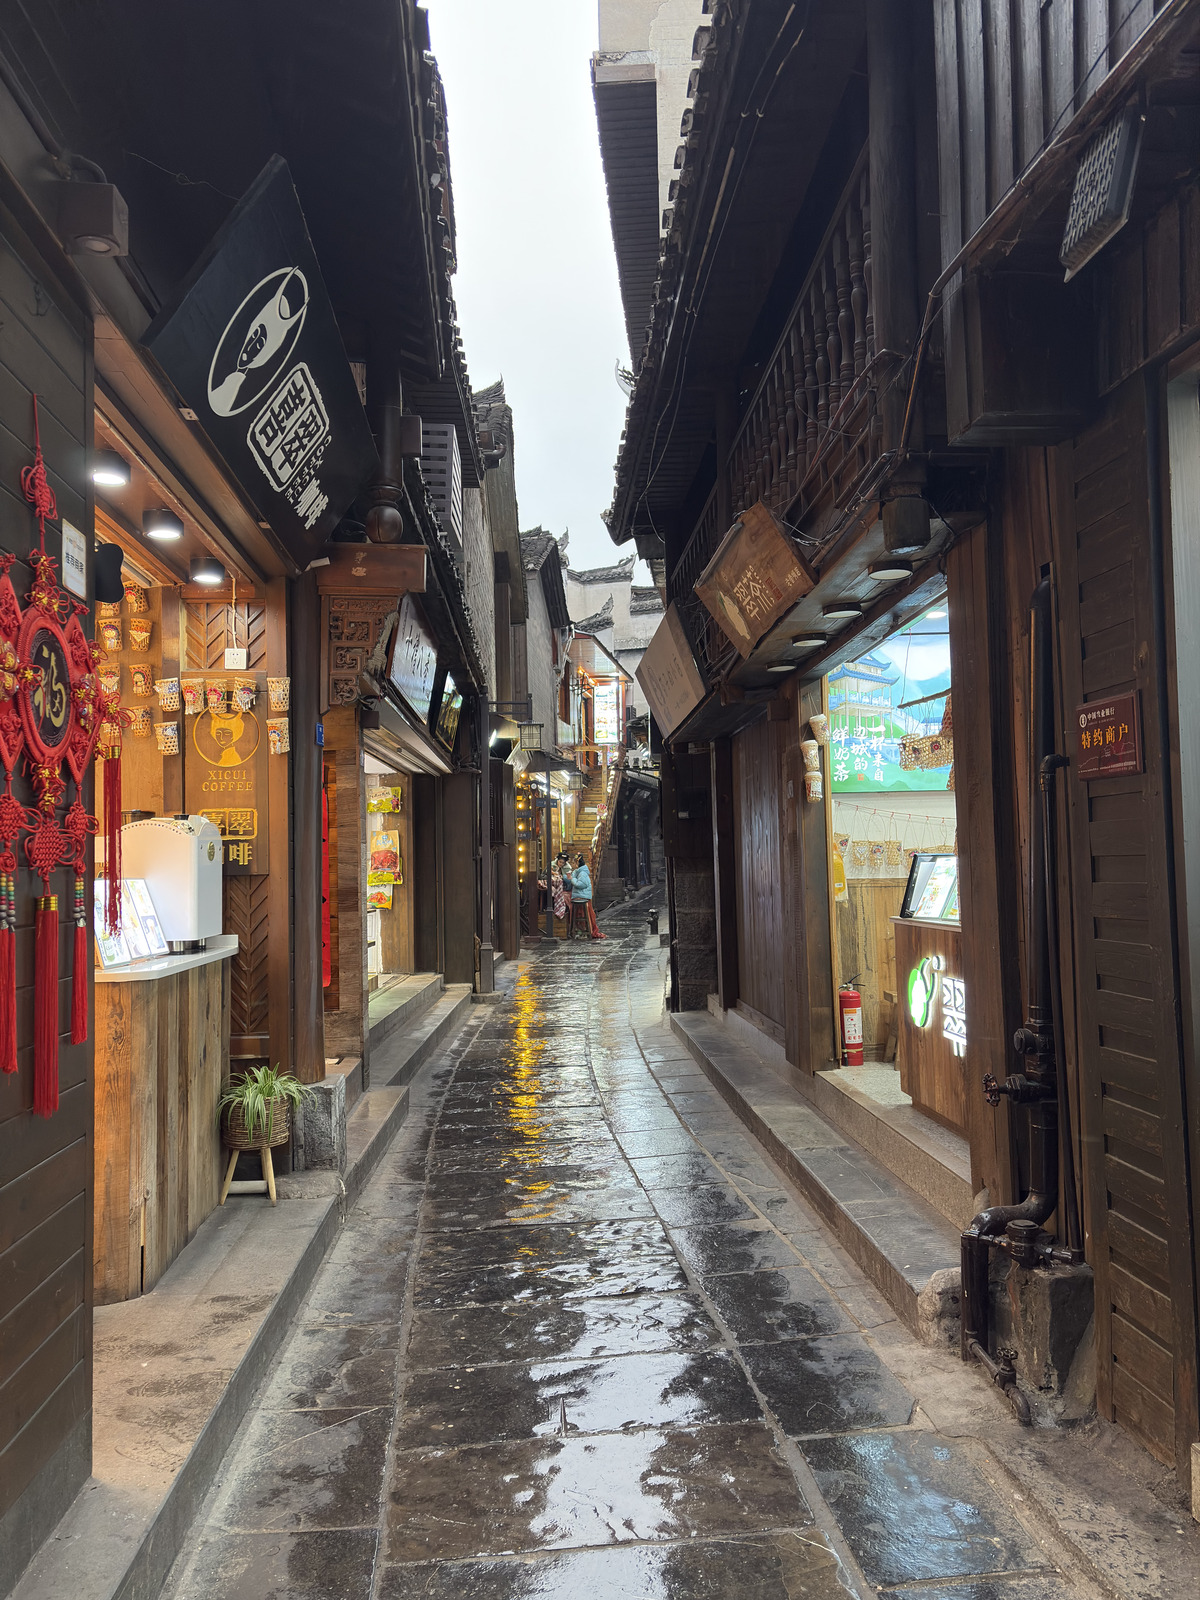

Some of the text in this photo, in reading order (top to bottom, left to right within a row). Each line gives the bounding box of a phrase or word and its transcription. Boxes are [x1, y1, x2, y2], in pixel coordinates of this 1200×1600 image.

[256, 377, 323, 473] 喜翠
[284, 434, 333, 501] COFFEE
[288, 457, 325, 505] XICUI
[293, 476, 330, 531] 咖啡
[1081, 723, 1129, 749] 特约商户
[1087, 706, 1115, 721] 中国农业银行
[832, 725, 851, 782] 鲜奶茶
[850, 725, 872, 771] 边城的
[867, 725, 888, 782] 一杯来自
[202, 781, 253, 792] COFFEE
[207, 770, 247, 780] XICUI
[222, 842, 253, 866] 啡
